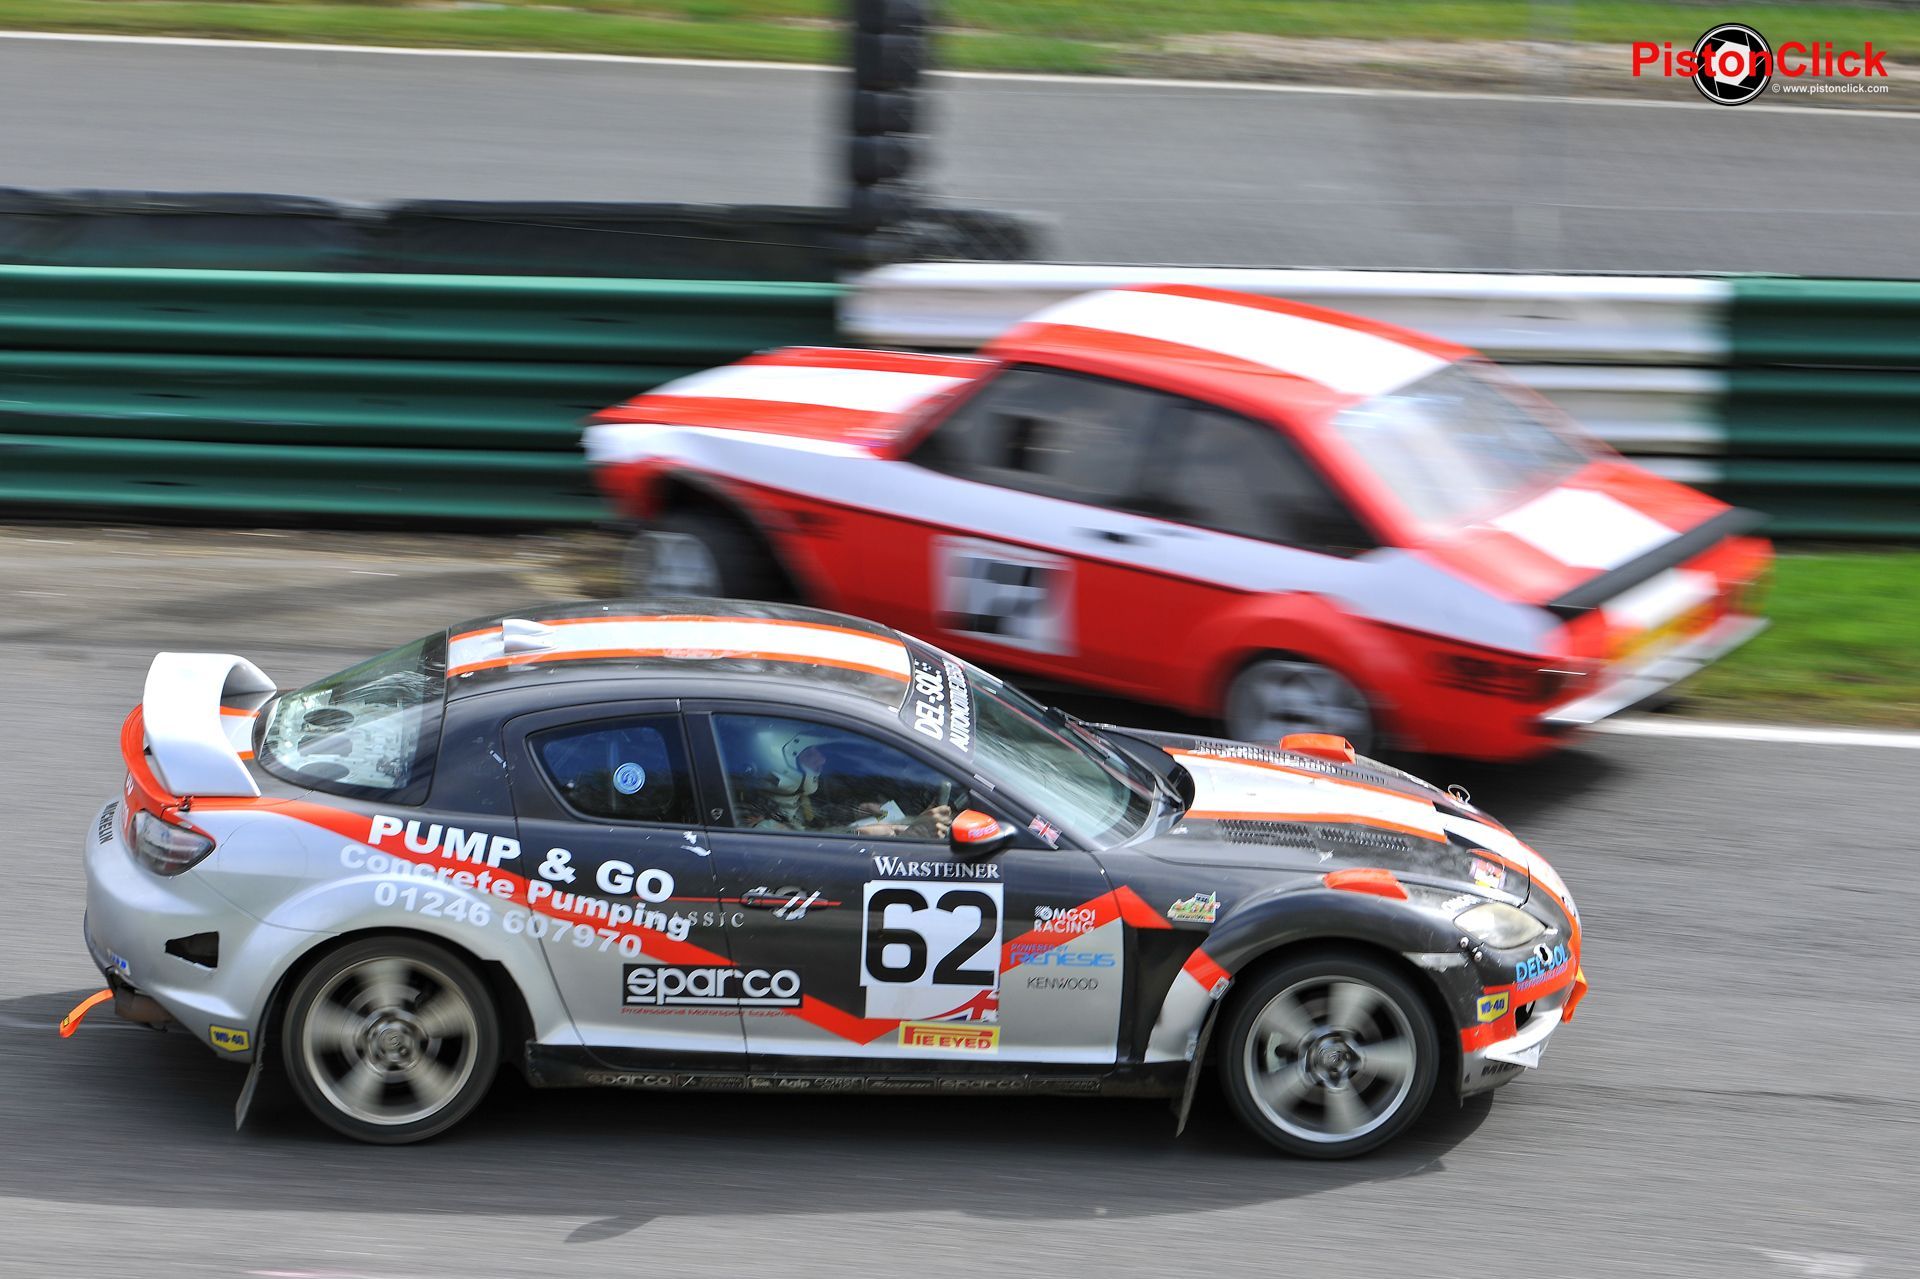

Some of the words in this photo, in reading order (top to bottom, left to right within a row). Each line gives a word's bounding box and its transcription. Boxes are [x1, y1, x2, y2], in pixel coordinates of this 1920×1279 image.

[914, 668, 945, 741] DEL-SOL
[368, 815, 521, 868] PUMP
[538, 847, 577, 884] &
[596, 859, 675, 902] GO
[340, 844, 514, 900] Concrete
[528, 879, 691, 942] Pumping
[374, 882, 491, 927] 01246
[502, 909, 642, 958] 607970
[865, 888, 998, 986] 62
[1034, 919, 1095, 934] RACING
[627, 967, 800, 1005] sparco
[1010, 952, 1116, 967] RENESIS
[1026, 976, 1099, 991] KENWOOD
[940, 1036, 991, 1049] EYED
